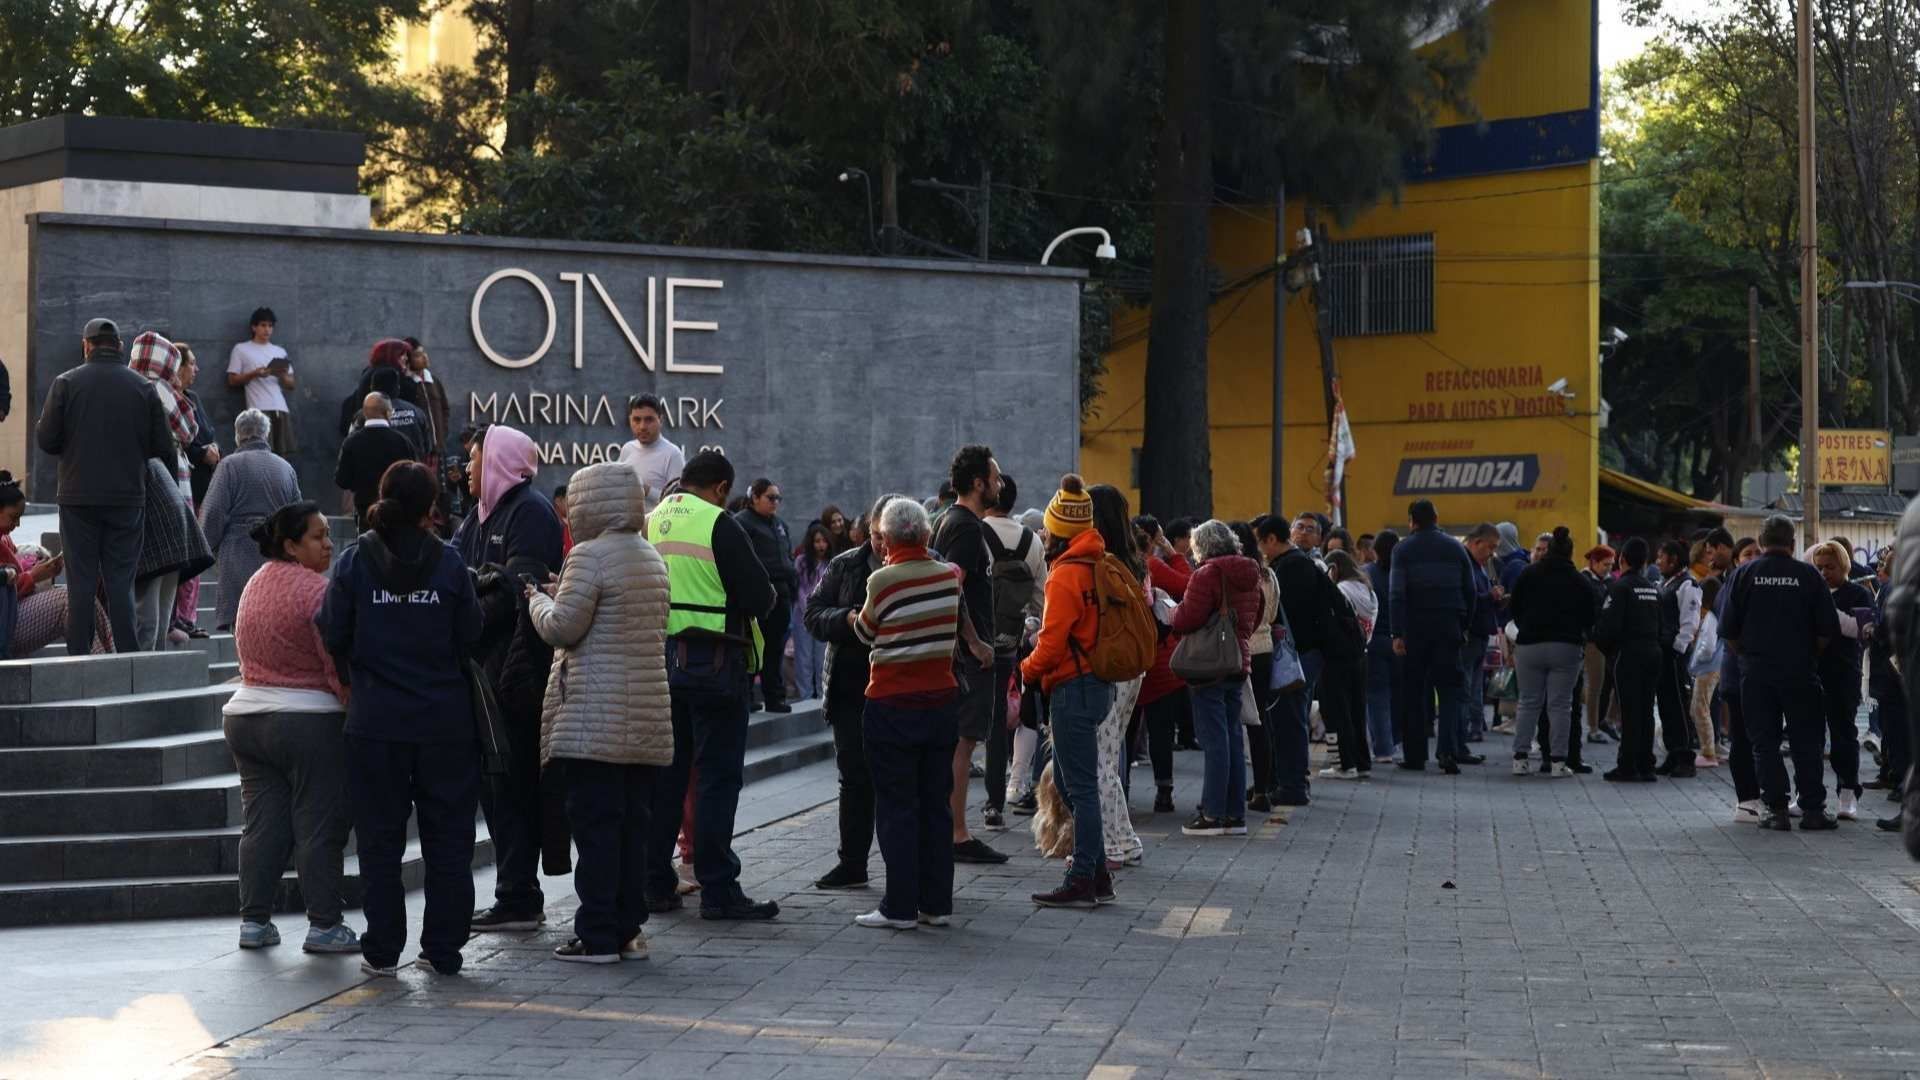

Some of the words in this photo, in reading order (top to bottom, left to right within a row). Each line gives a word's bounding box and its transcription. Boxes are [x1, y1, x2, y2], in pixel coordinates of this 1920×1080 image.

[1425, 365, 1543, 392] REFACCIONARIA
[471, 391, 616, 427] MARINA
[629, 395, 724, 429] ARK
[1408, 403, 1444, 420] PARA
[1452, 401, 1497, 418] AUTOS
[1502, 399, 1511, 417] Y
[1515, 397, 1566, 416] MOTOS
[1818, 435, 1872, 450] POSTRES
[1406, 461, 1525, 489] MENDOZA
[1818, 456, 1889, 481] ARINA
[1754, 576, 1799, 587] LIMPIEZA
